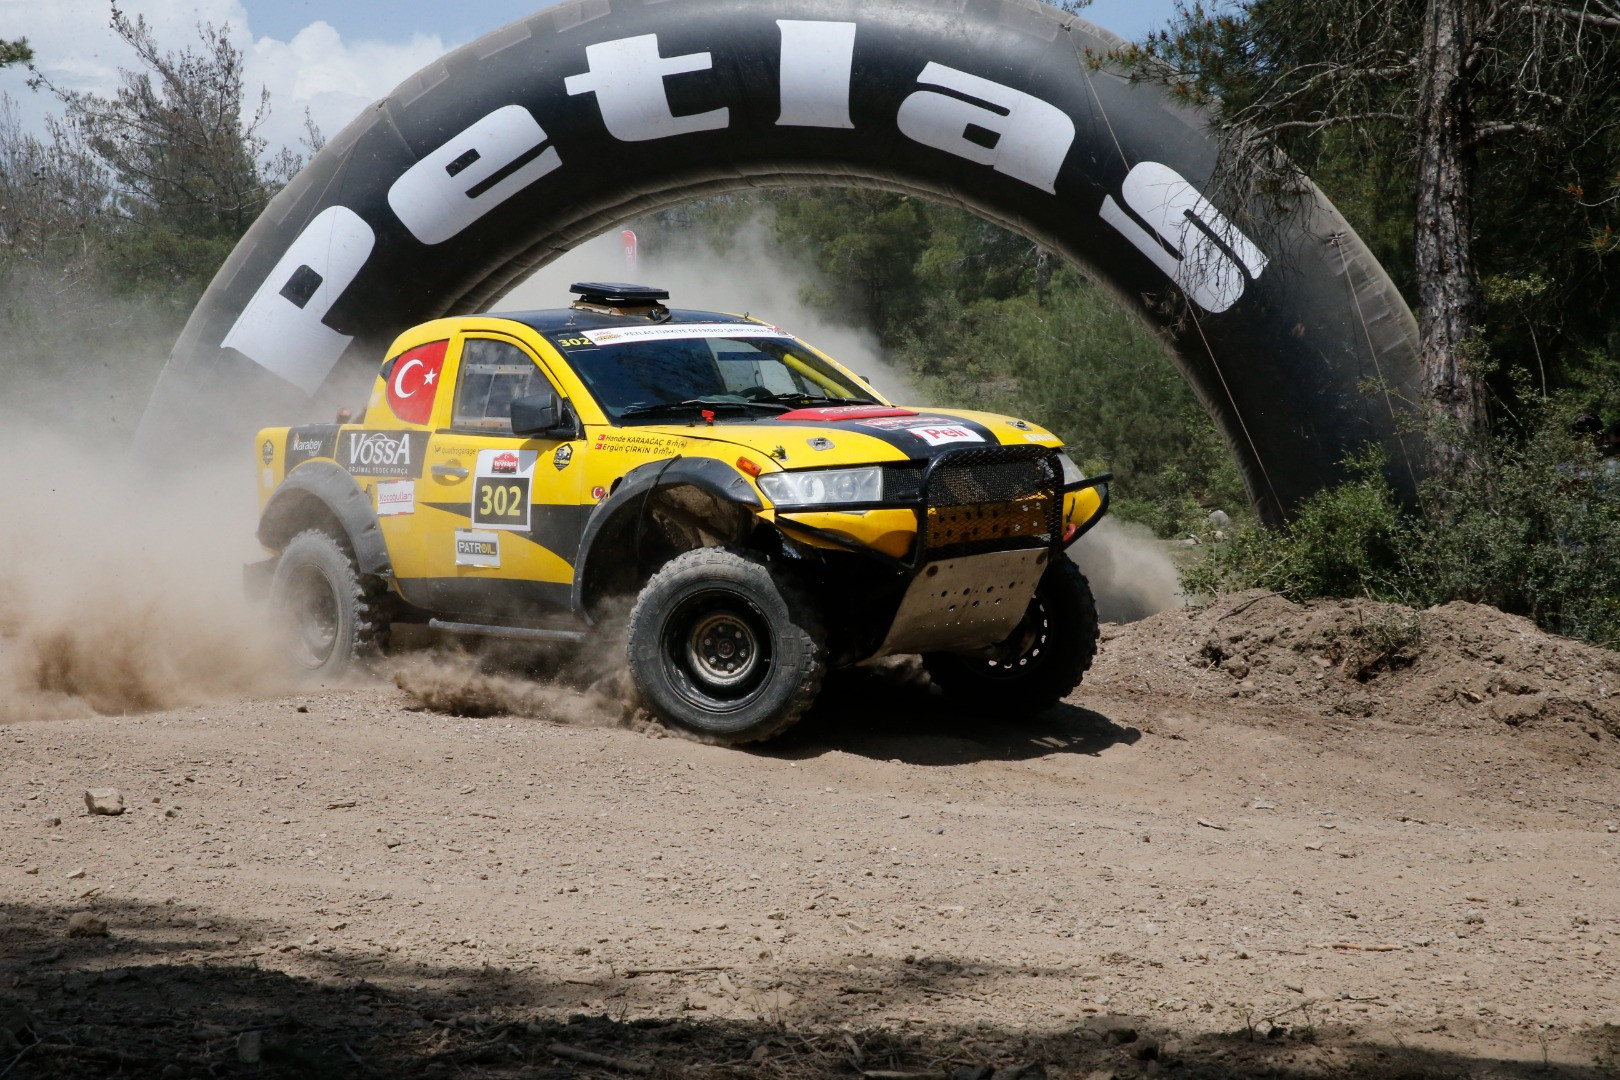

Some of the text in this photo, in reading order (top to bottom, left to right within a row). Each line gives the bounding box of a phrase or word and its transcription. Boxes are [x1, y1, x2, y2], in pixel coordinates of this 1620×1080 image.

[558, 338, 592, 347] 302
[605, 435, 626, 443] Hande
[922, 427, 969, 440] Peli
[293, 434, 322, 453] Karabey
[602, 443, 623, 452] Ergün
[390, 467, 408, 475] PARÇA
[480, 485, 521, 516] 302
[458, 541, 496, 555] PATROIL
